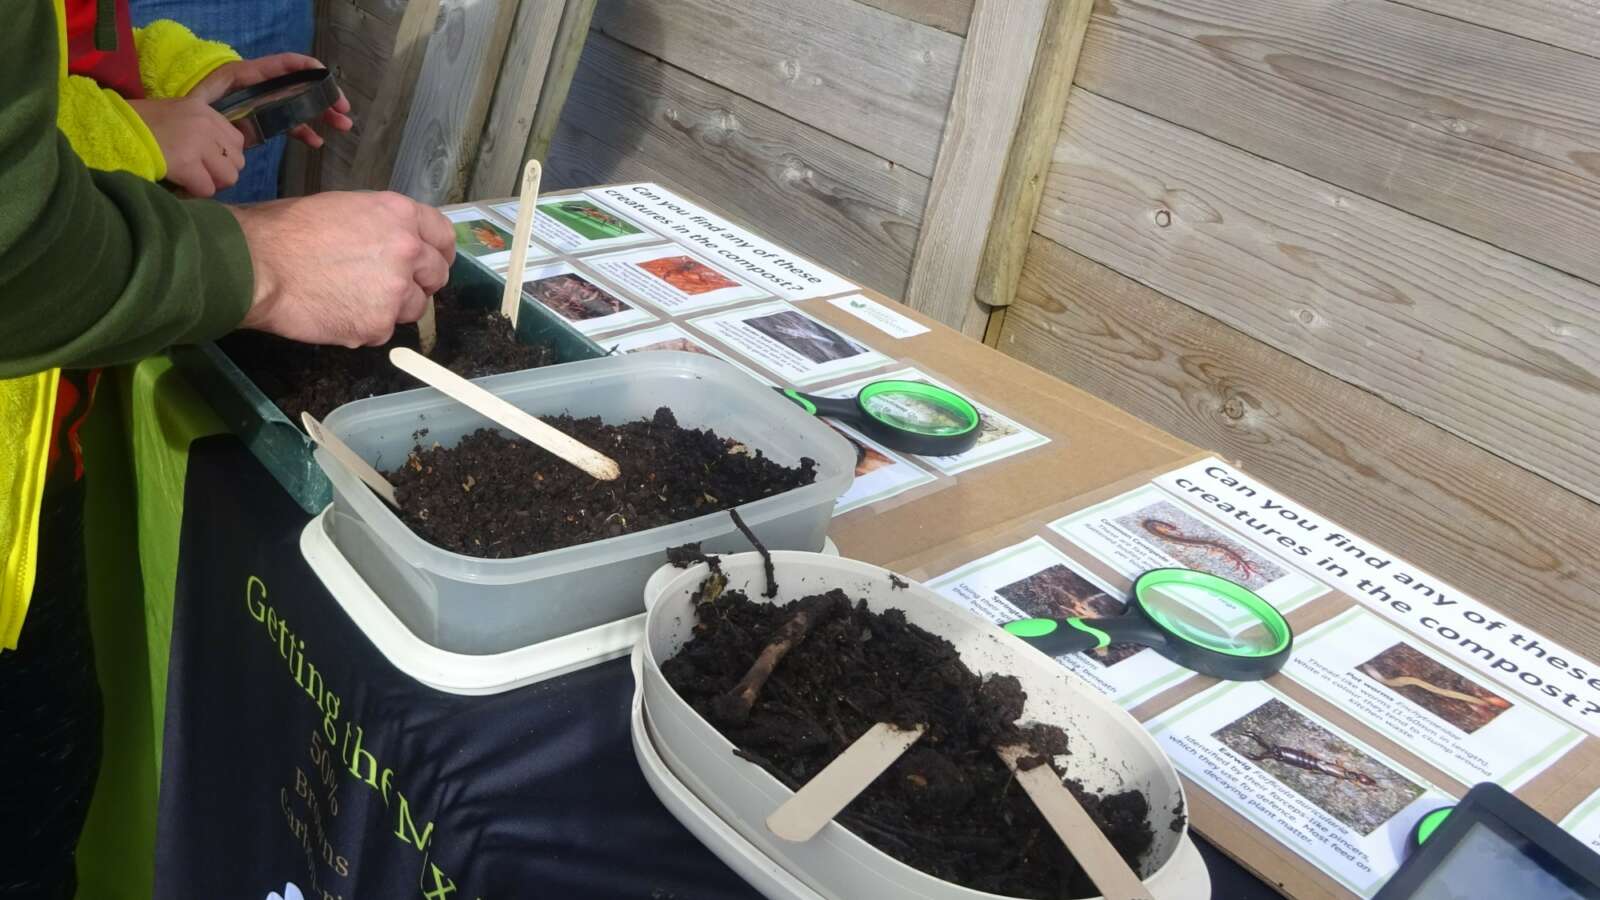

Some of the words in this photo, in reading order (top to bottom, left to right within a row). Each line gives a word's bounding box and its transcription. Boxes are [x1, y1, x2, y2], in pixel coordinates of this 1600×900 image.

[604, 189, 675, 226] creatures
[671, 224, 690, 235] in
[689, 234, 719, 250] the
[717, 249, 804, 292] compost?
[632, 186, 661, 201] Can
[656, 199, 690, 217] you
[689, 213, 726, 233] find
[720, 229, 754, 249] any
[752, 248, 779, 261] of
[772, 255, 822, 284] these
[1174, 477, 1313, 557] creatures
[1316, 556, 1349, 578] in
[1356, 578, 1413, 614] the
[1419, 615, 1600, 716] compost?
[1204, 466, 1257, 498] Can
[1259, 498, 1319, 532] you
[1324, 532, 1391, 570] find
[1393, 571, 1459, 607] any
[1463, 610, 1507, 632] of
[246, 575, 341, 746] Getting
[1293, 656, 1321, 675] White
[1360, 688, 1391, 709] worms
[1363, 682, 1395, 702] worms
[310, 730, 339, 816] 50%
[1169, 735, 1198, 756] which
[1198, 754, 1220, 770] they
[1220, 769, 1239, 783] use
[1239, 781, 1255, 793] for
[1255, 793, 1297, 823] defence.
[1301, 823, 1330, 845] Most
[1330, 843, 1356, 862] feed
[1355, 861, 1372, 873] on
[1184, 735, 1231, 767] Identified
[1230, 765, 1244, 776] by
[1243, 774, 1269, 792] their
[1269, 791, 1329, 833] forceps-like
[1203, 769, 1248, 800] decaying
[1247, 799, 1277, 819] plant
[1218, 747, 1252, 771] Earwig
